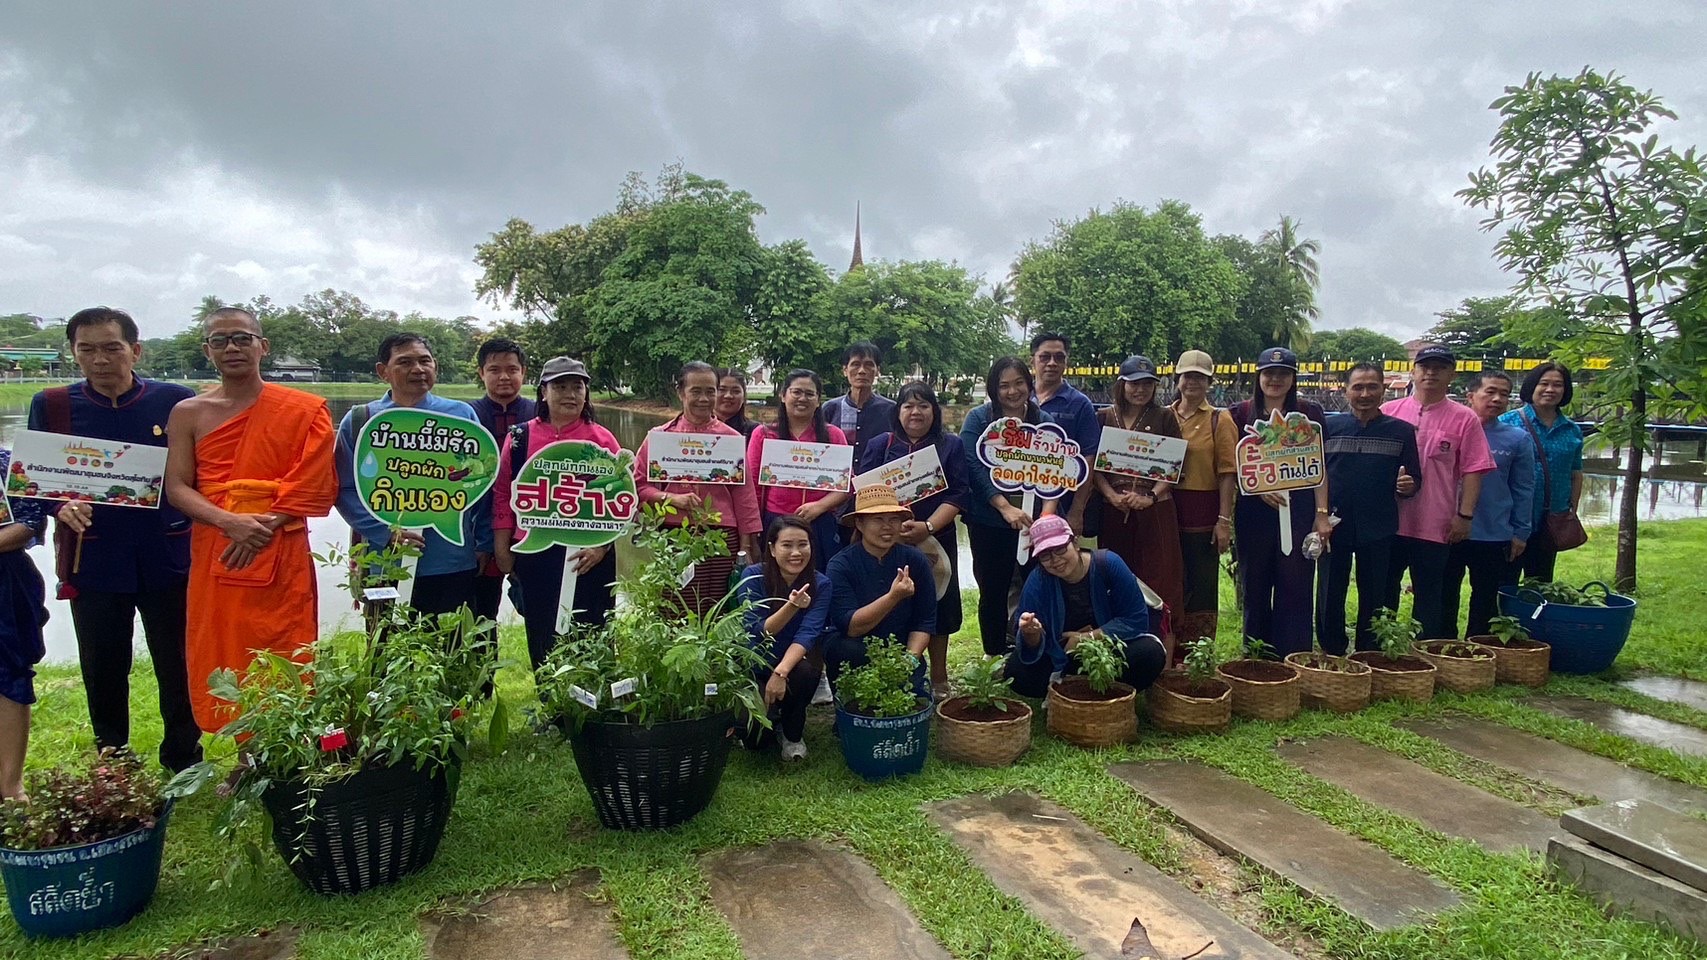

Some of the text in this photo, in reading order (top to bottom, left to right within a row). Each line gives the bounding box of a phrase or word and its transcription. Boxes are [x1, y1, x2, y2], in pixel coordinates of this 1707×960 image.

[370, 420, 480, 455] บ้านนี้มีรัก
[1002, 419, 1078, 457] ริม รั้วบ้าน
[995, 449, 1065, 469] ปลูกผักนานาพันธุ์
[1265, 444, 1319, 459] ปลูกผักสวนครัว
[26, 463, 152, 484] สำนักงานพัฒนาชุมชนจังหวัดสุโขทัย
[386, 457, 446, 480] ปลูกผัก
[533, 458, 614, 475] ปลูกผักกินเอง
[993, 465, 1078, 488] ลดค่าใช้จ่าย
[1241, 446, 1320, 488] รั้ว กินได้
[369, 478, 467, 511] กินเอง
[515, 475, 635, 518] สร้าง
[521, 513, 626, 531] ความมั่นคงทางอาหาร
